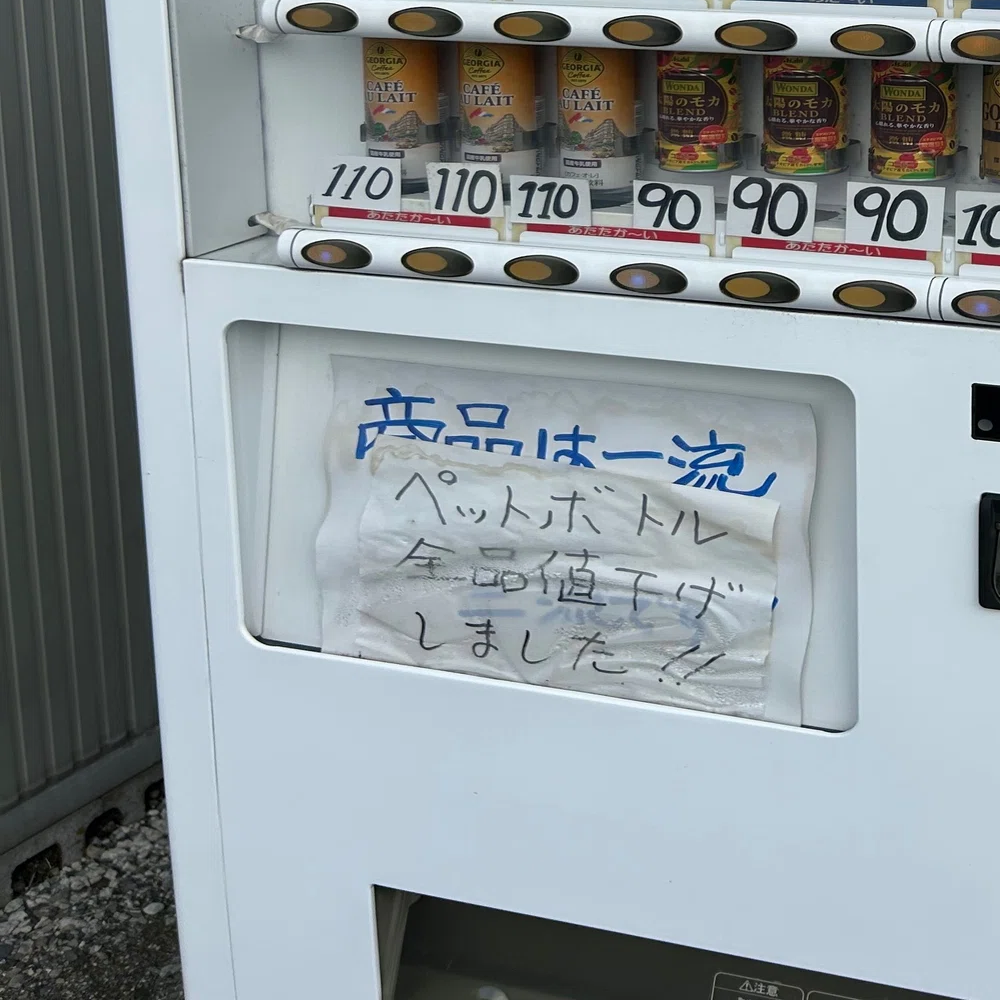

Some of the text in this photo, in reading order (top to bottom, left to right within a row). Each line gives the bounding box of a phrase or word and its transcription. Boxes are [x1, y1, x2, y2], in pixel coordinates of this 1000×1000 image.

[366, 80, 405, 93] CAFÉ
[462, 83, 502, 95] CAFÉ
[664, 81, 700, 91] WONDA
[775, 82, 814, 93] WONDA
[882, 86, 922, 98] WONDA
[377, 92, 417, 103] LAIT
[562, 86, 602, 100] CAFÉ
[473, 95, 515, 107] LAIT
[574, 100, 615, 111] LAIT
[662, 107, 706, 116] BLEND
[773, 109, 819, 118] BLEND
[880, 113, 926, 122] BLEND
[321, 163, 394, 201] 110
[434, 167, 499, 216] 110
[517, 181, 581, 220] 110
[637, 182, 702, 232] 90
[732, 176, 809, 237] 90
[853, 185, 929, 242] 90
[395, 468, 730, 546] ペットボトル
[395, 537, 746, 621] 全品値下げ
[753, 982, 780, 998] 注意
